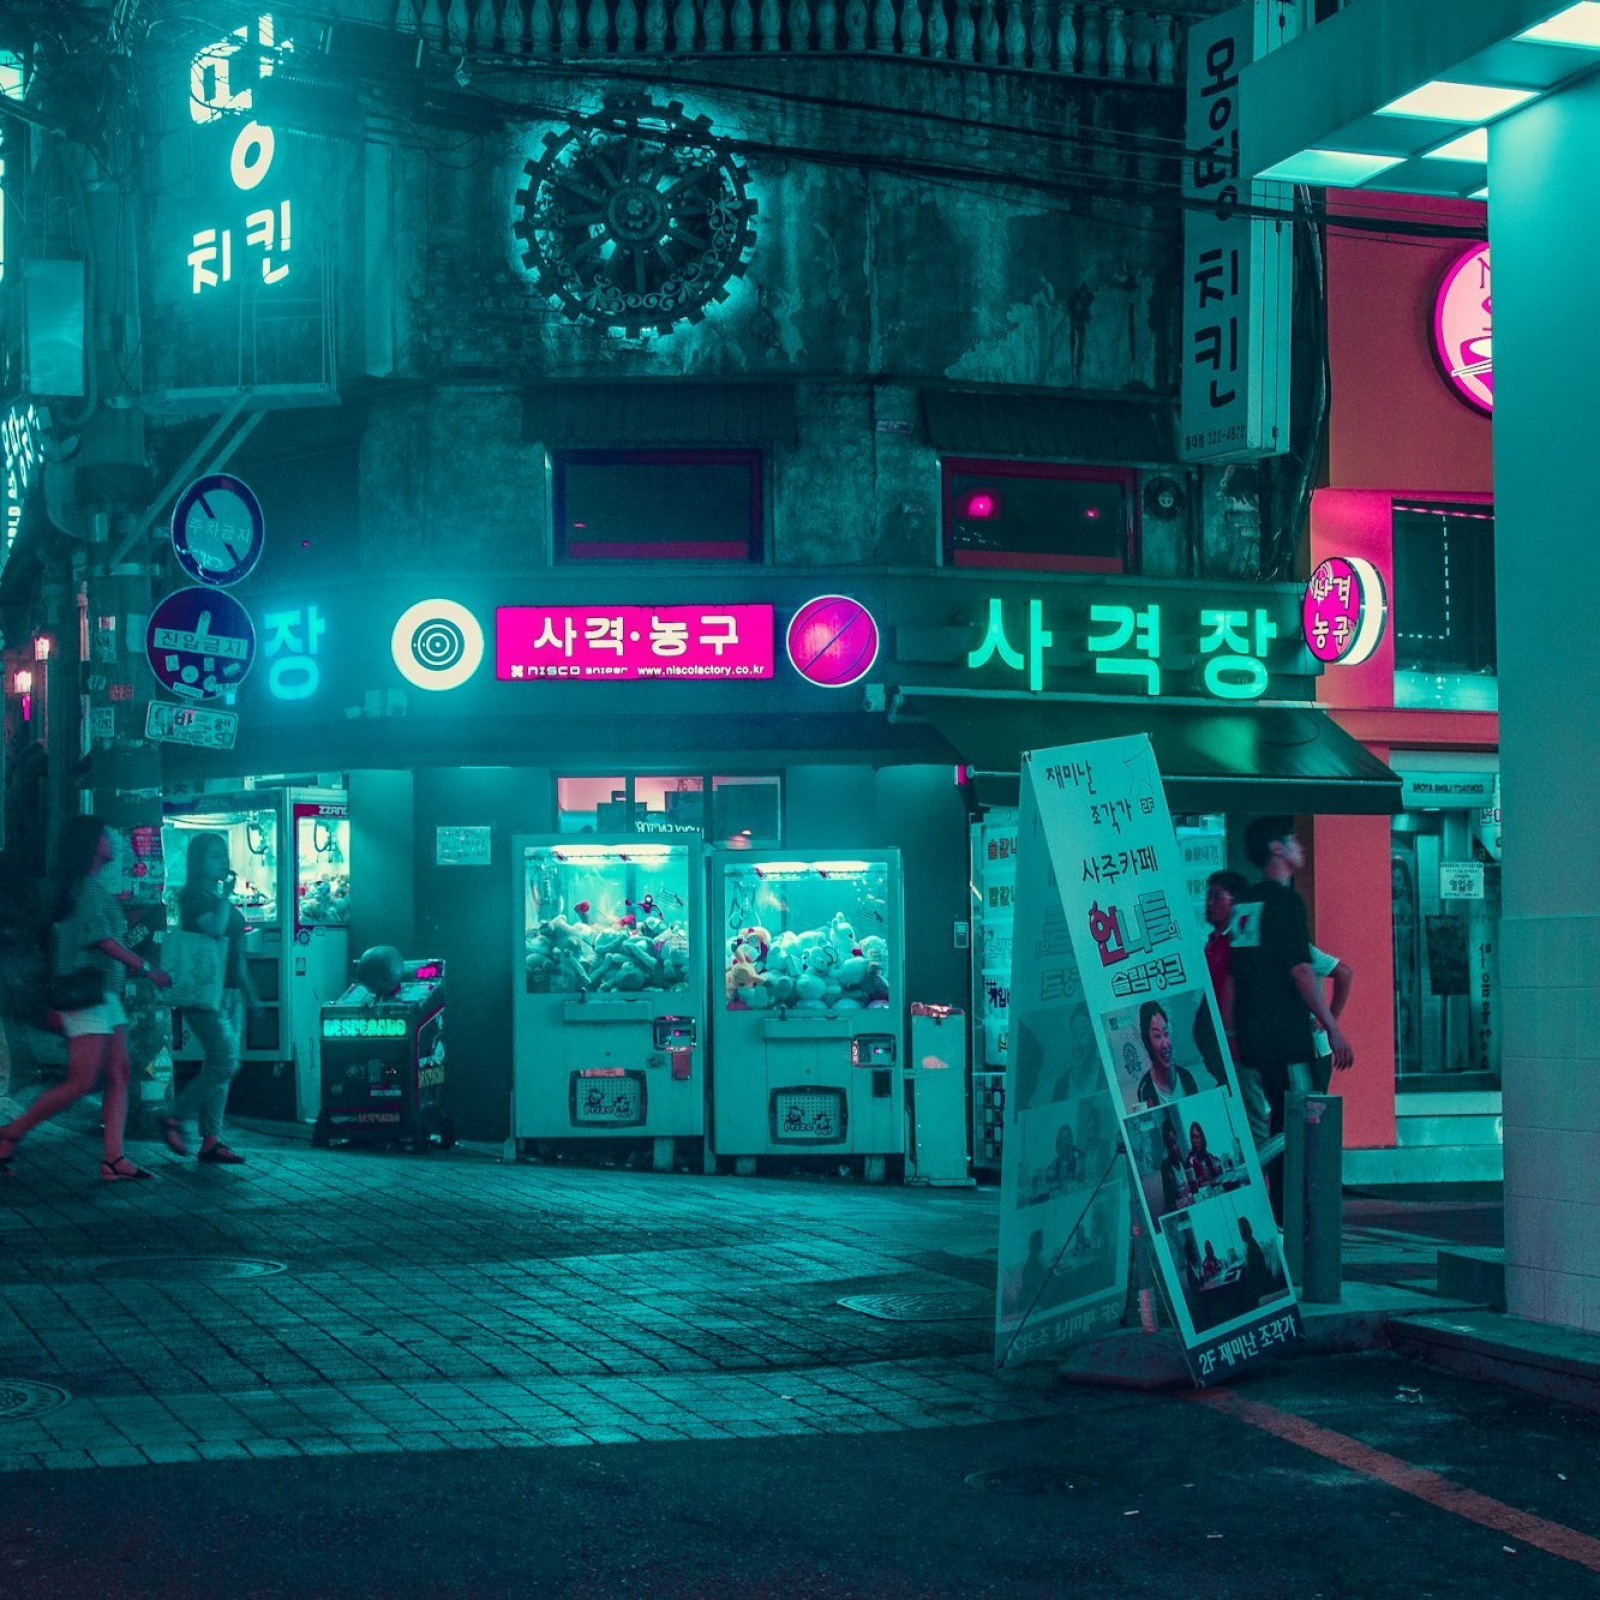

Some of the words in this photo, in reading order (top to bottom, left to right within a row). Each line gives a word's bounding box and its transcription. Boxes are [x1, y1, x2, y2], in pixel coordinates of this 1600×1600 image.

[187, 200, 291, 294] 치킨
[1193, 248, 1238, 408] 치킨
[188, 518, 252, 543] 주차금지
[1310, 574, 1352, 610] 사격
[161, 631, 241, 655] 진입금지
[967, 598, 1277, 699] 사격장
[1312, 612, 1350, 649] 농구
[264, 605, 324, 700] 장
[637, 664, 765, 676] www.niscofactory.co.kr
[1045, 760, 1097, 795] 재미난
[1090, 798, 1132, 834] 조각가
[1082, 845, 1158, 884] 사주카페
[1089, 890, 1182, 967] 언니들의
[1111, 952, 1187, 998] 슬램덩크
[323, 1018, 407, 1037] DESPERADO
[1198, 1348, 1217, 1375] 2F
[1218, 1331, 1259, 1366] 재미난
[1259, 1314, 1296, 1347] 조각가
